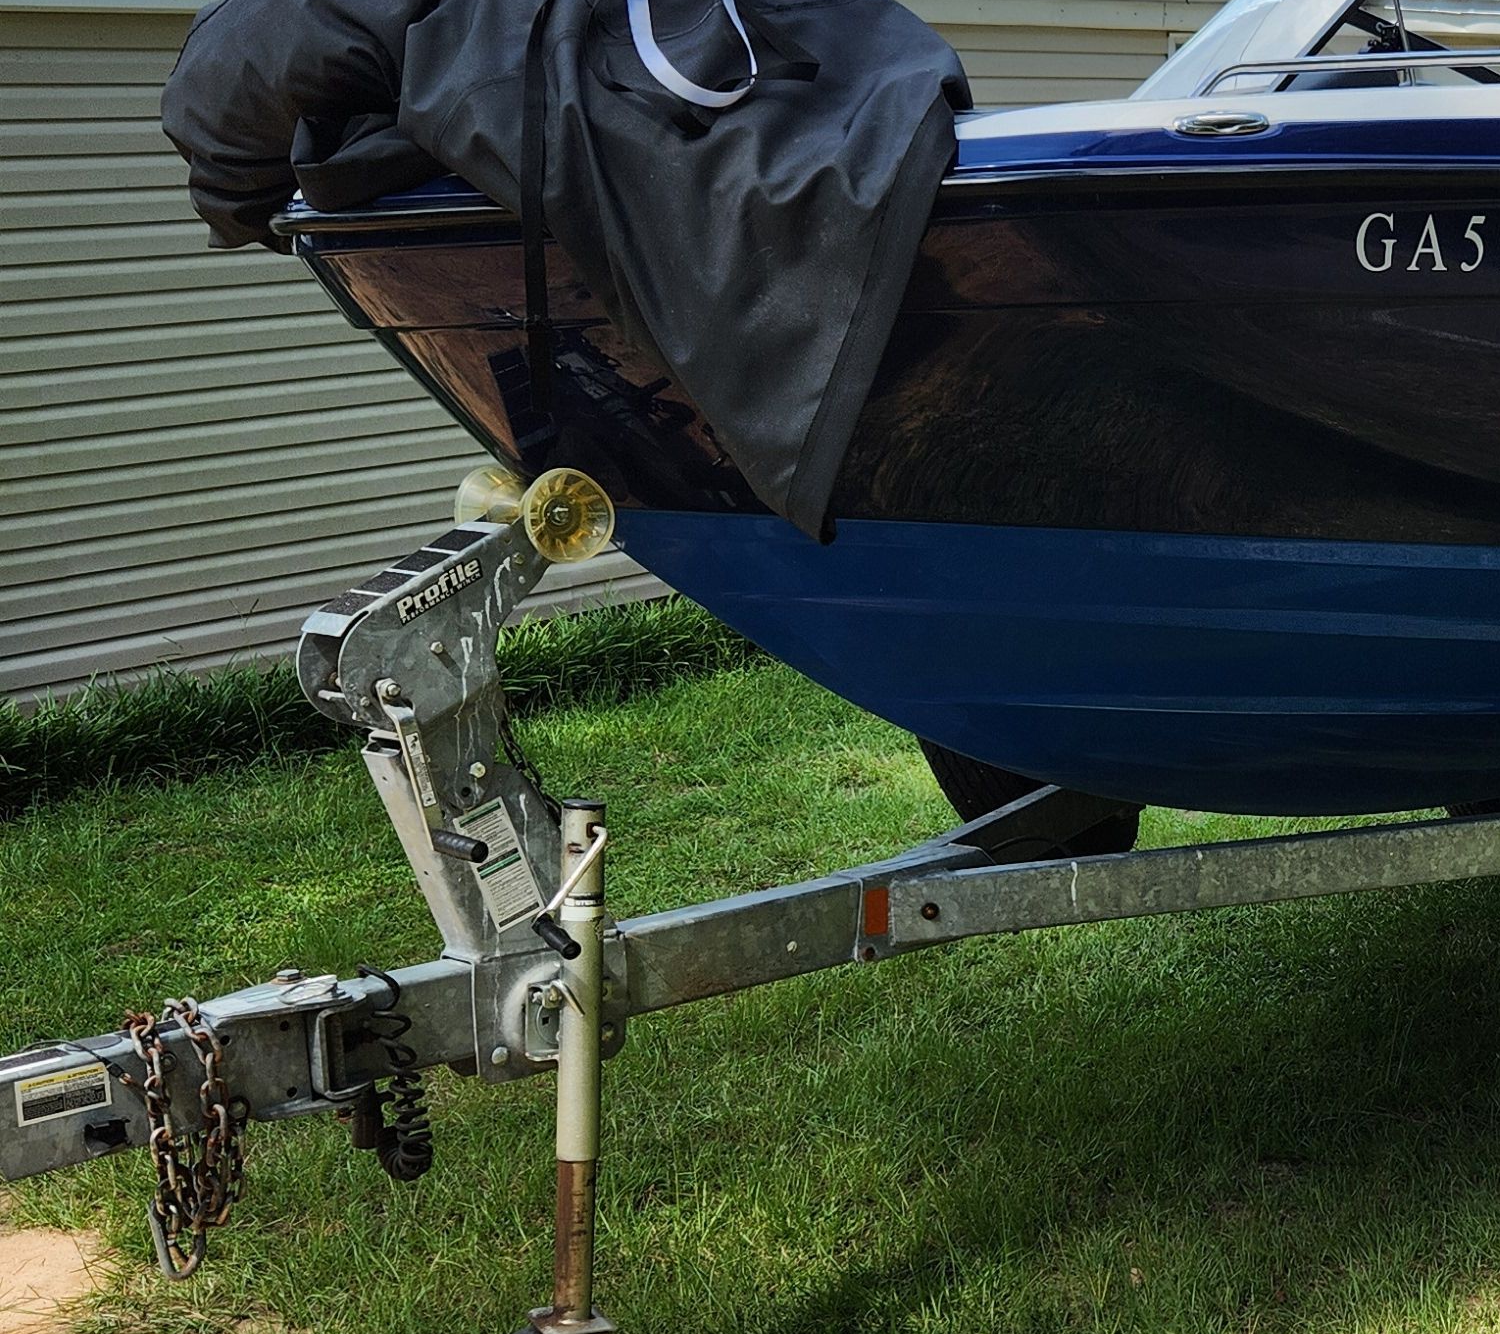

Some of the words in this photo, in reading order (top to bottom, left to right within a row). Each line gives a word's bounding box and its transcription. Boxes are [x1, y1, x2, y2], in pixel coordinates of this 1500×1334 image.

[396, 559, 480, 619] Profile
[401, 586, 455, 624] PERFORMANCE
[456, 571, 481, 591] WINCH
